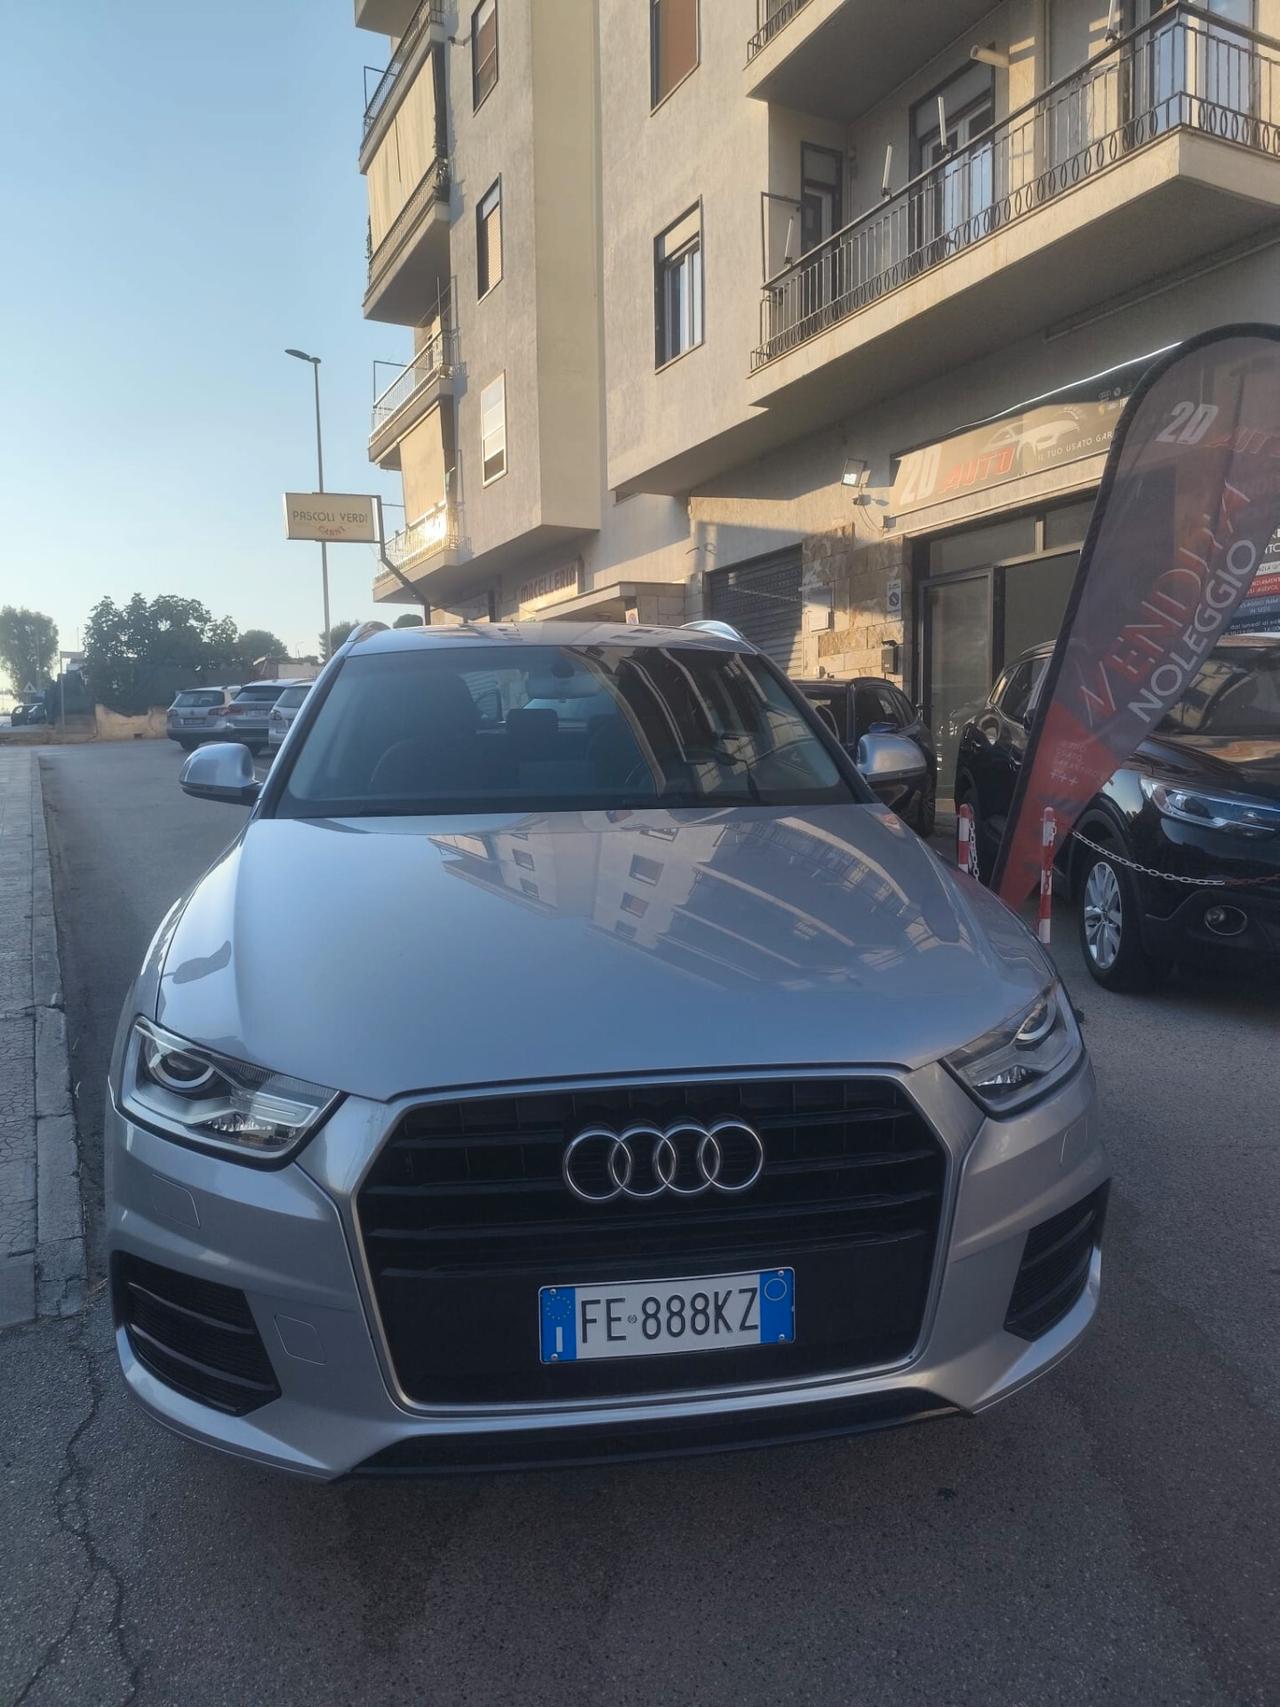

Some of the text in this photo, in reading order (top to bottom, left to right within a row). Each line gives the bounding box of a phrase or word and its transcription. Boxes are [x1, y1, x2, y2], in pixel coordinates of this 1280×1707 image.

[941, 446, 1016, 493] AUTO
[1046, 447, 1063, 460] TUO
[1066, 438, 1092, 453] USATO
[293, 510, 368, 523] PASCOLI VERDI
[1128, 539, 1257, 723] NOLEGGIO
[581, 1297, 627, 1344] FE
[641, 1287, 759, 1341] 888KZ
